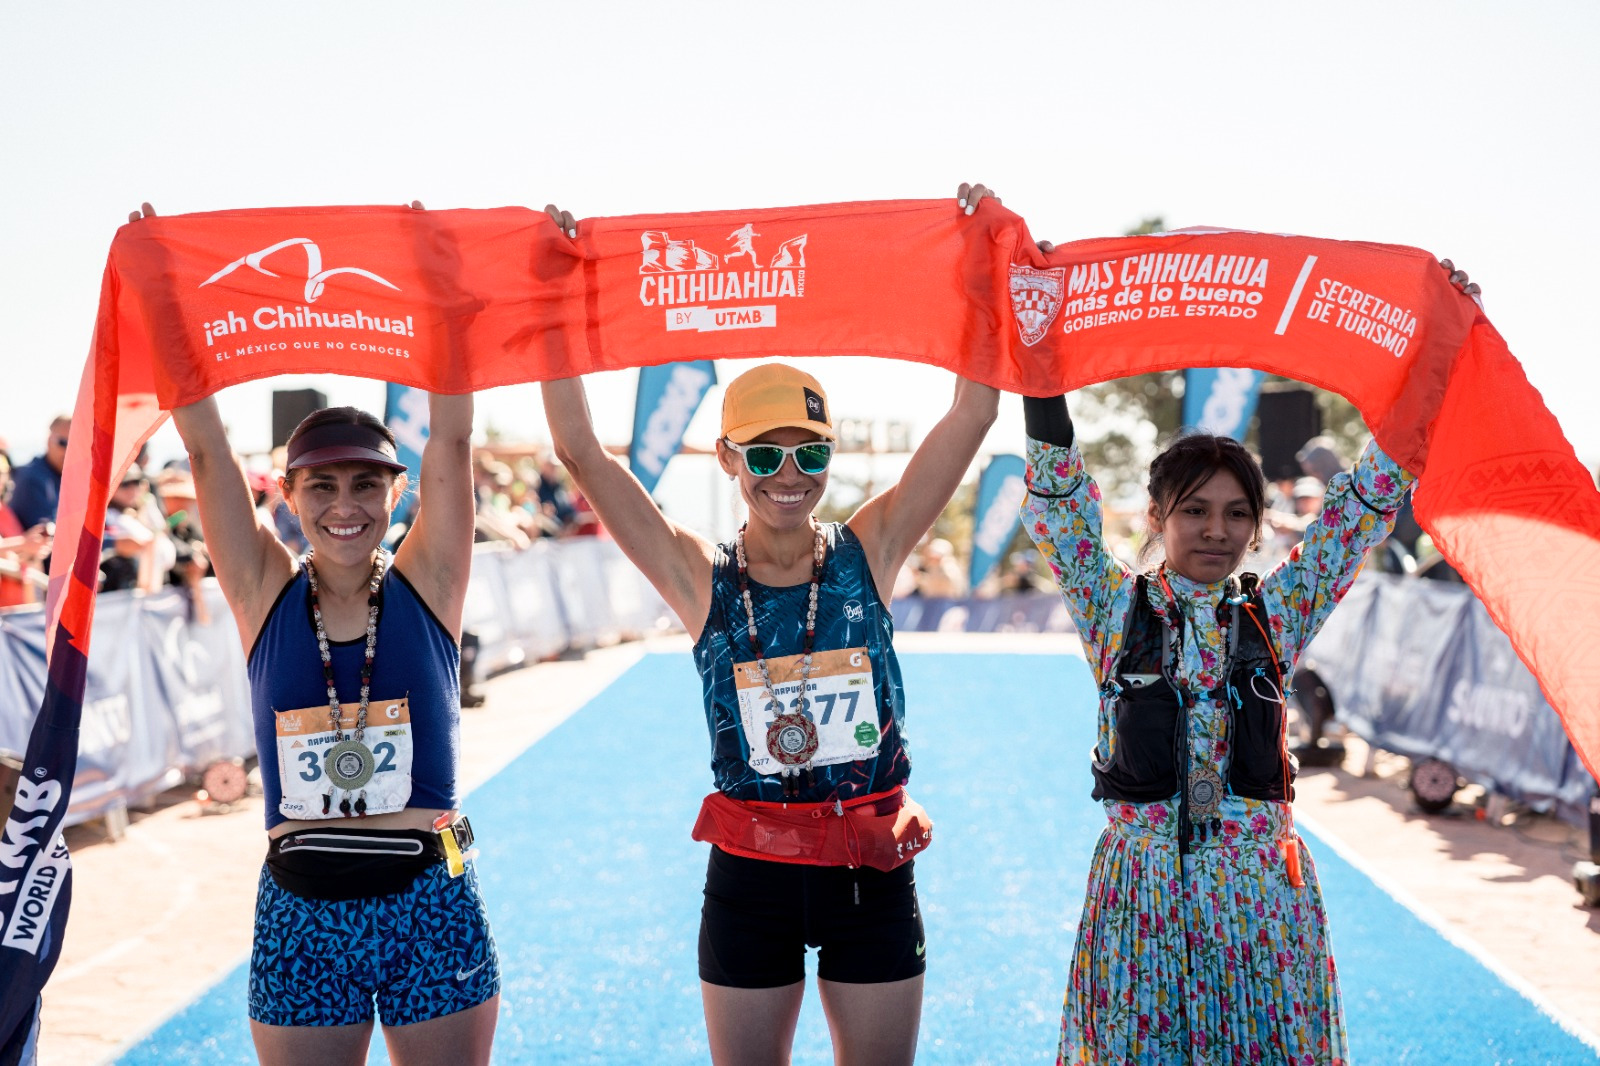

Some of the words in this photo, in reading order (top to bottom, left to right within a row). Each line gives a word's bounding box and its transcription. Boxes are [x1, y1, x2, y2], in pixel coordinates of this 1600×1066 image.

[639, 269, 797, 306] CHIHUAHUA
[797, 269, 806, 298] MEXICO
[1067, 259, 1117, 297] MAS
[1120, 252, 1269, 289] CHIHUAHUA
[1064, 291, 1108, 317] más
[1113, 286, 1144, 306] de
[1149, 283, 1174, 303] lo
[1179, 282, 1264, 306] bueno
[1315, 277, 1417, 338] SECRETARÍA
[203, 310, 248, 347] ¡ah
[252, 305, 415, 338] Chihuahua!
[675, 312, 693, 325] BY
[1063, 307, 1143, 334] GOBIERNO
[1147, 305, 1180, 319] DEL
[1184, 304, 1258, 319] ESTADO
[1306, 299, 1335, 324] DE
[1335, 307, 1408, 358] TURISMO
[216, 352, 231, 362] EL
[236, 341, 287, 357] MÉXICO
[293, 341, 320, 350] QUE
[326, 341, 344, 350] NO
[350, 342, 411, 359] CONOCES
[298, 741, 398, 782] 32
[752, 756, 770, 767] 3377
[12, 865, 58, 940] WORLD
